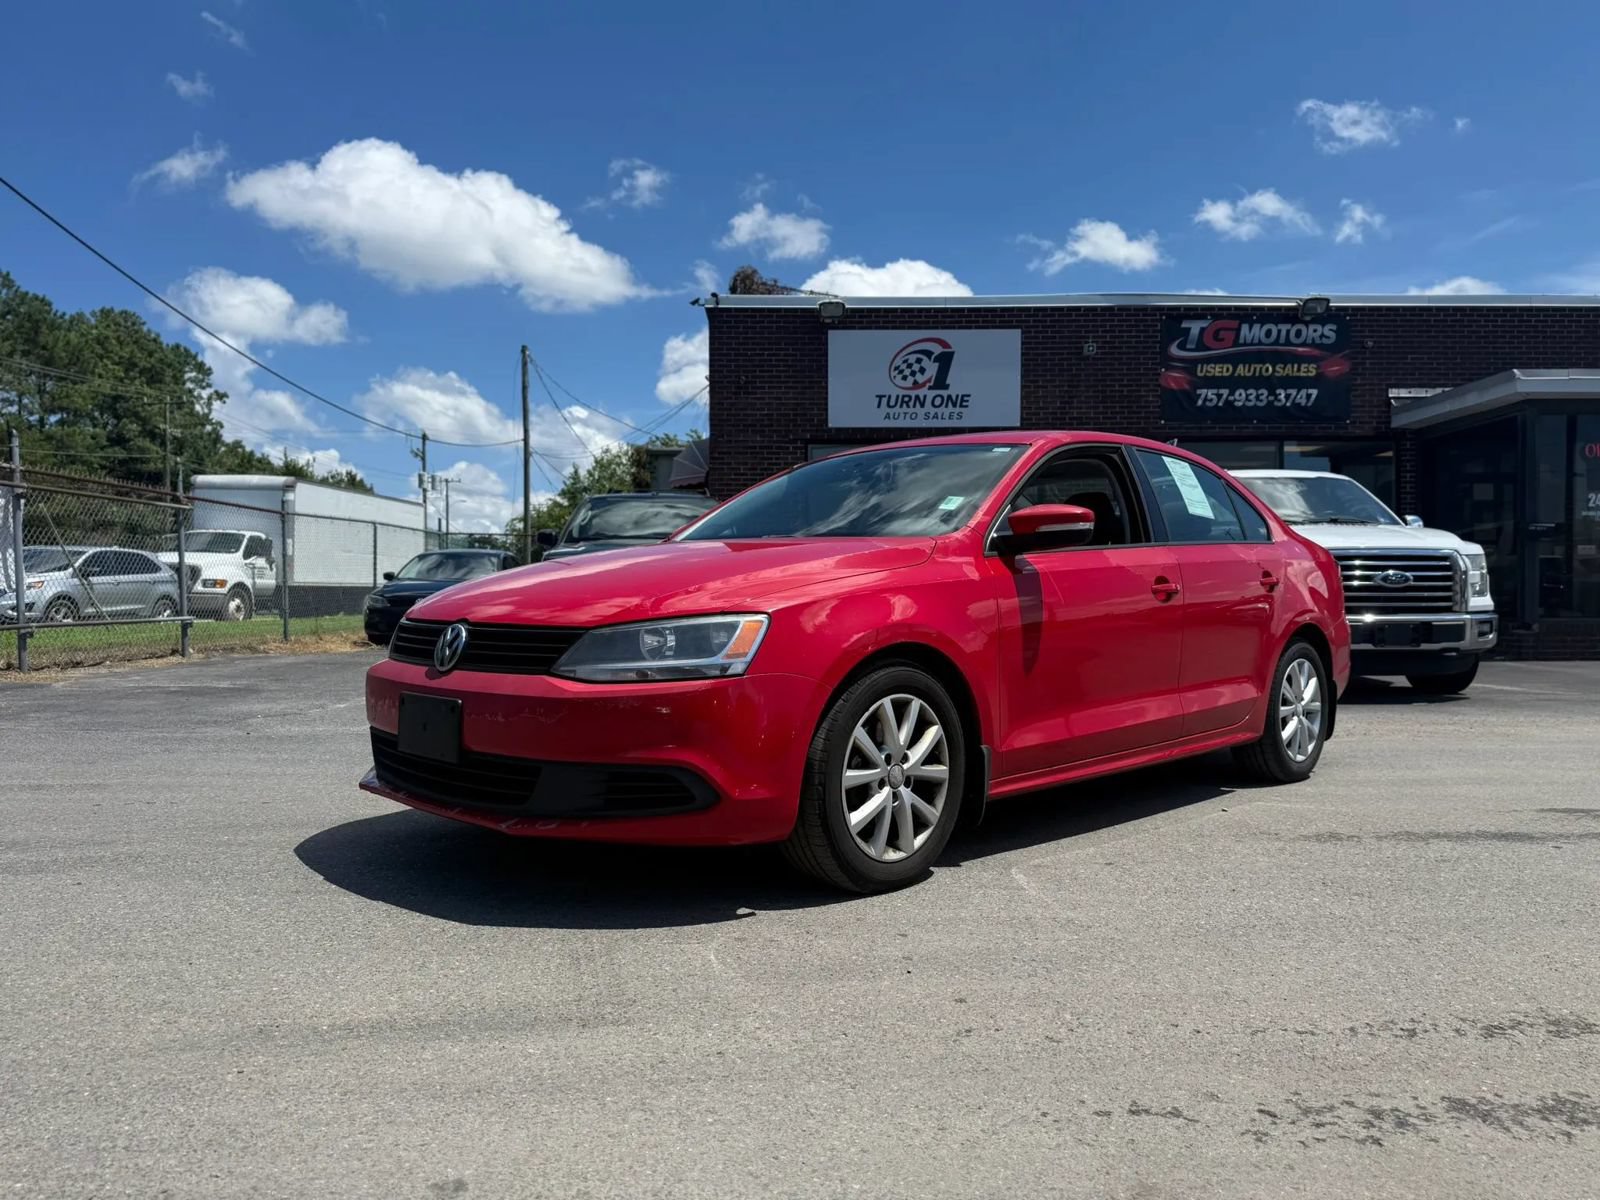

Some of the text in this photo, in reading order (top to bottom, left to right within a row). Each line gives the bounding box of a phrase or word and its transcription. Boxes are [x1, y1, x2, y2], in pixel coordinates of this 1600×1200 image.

[1181, 319, 1337, 349] TG MOTORS
[1196, 363, 1317, 377] USED AUTO SALES
[875, 394, 971, 409] TURN ONE
[1196, 388, 1318, 407] 757-933-3747
[883, 411, 964, 421] AUTO SALES
